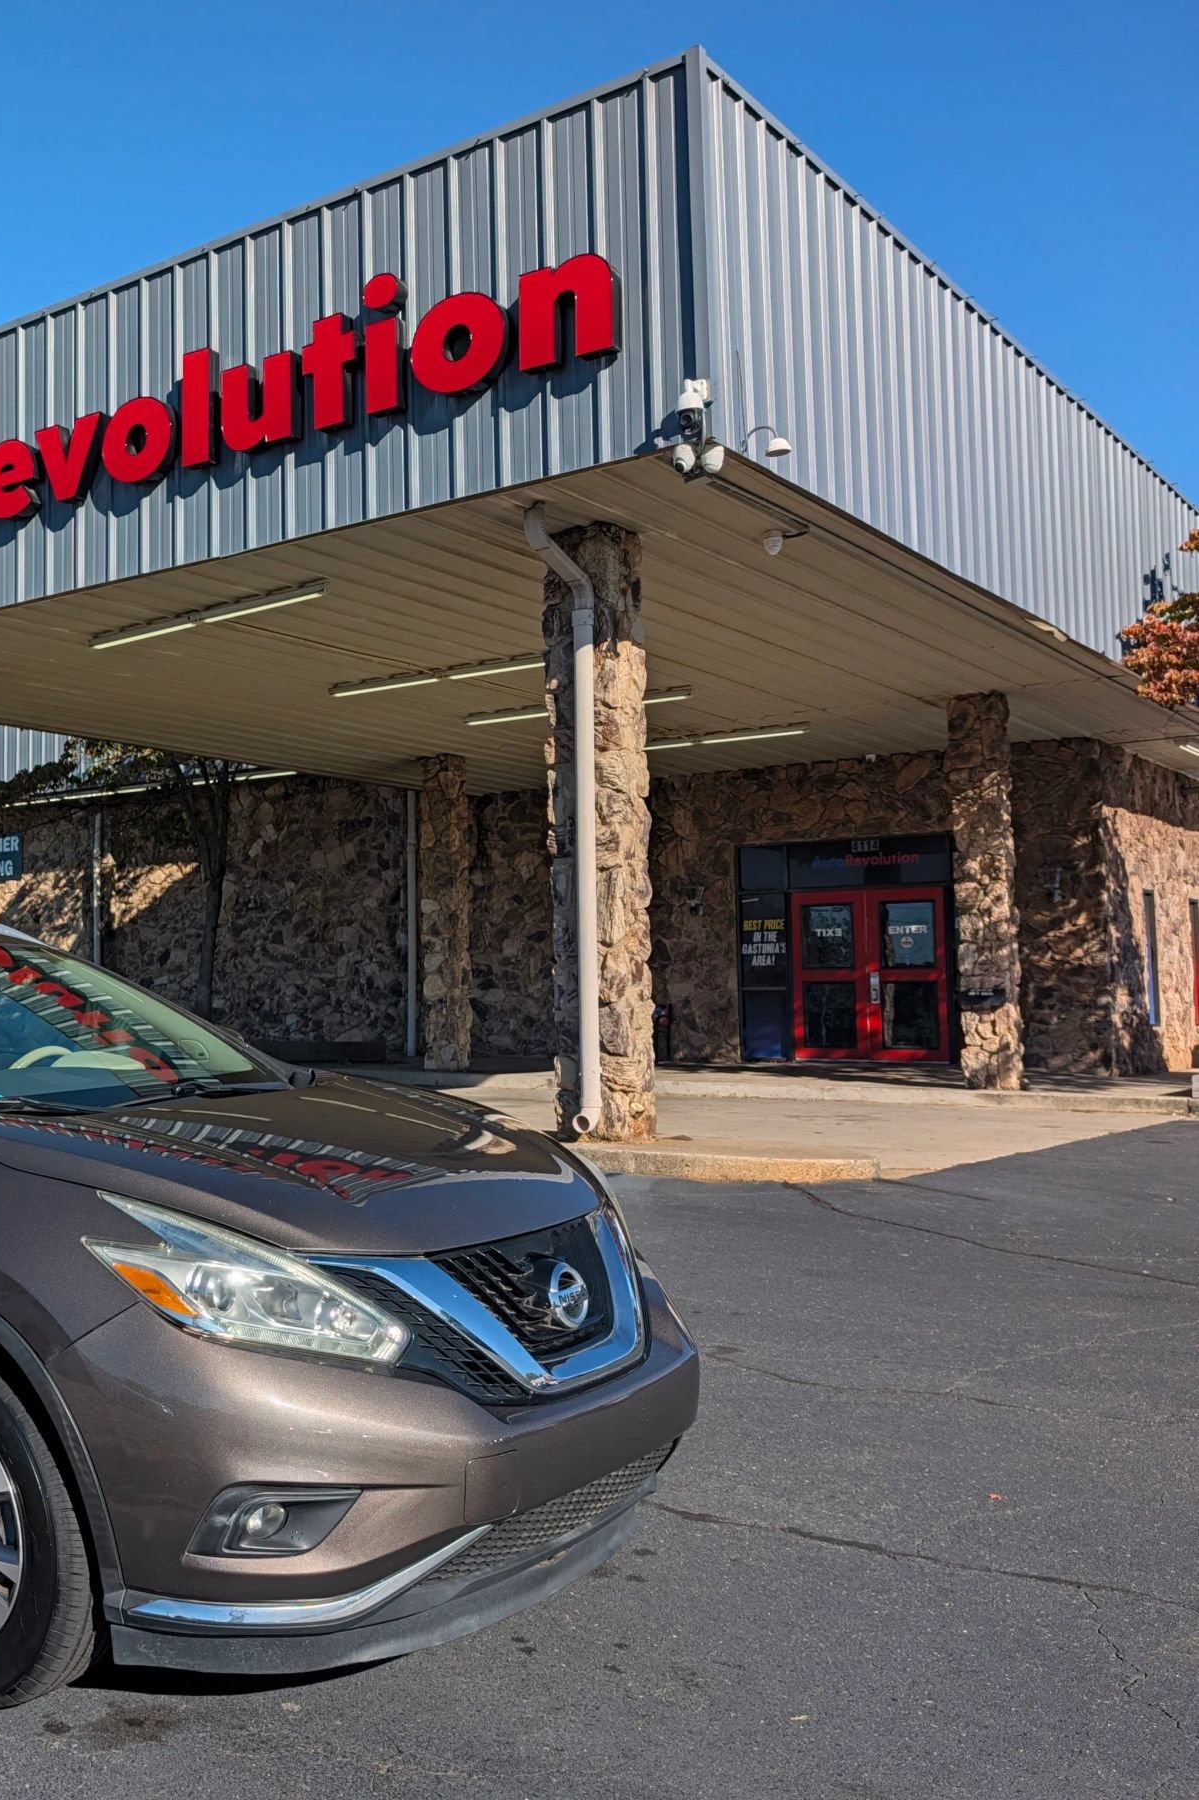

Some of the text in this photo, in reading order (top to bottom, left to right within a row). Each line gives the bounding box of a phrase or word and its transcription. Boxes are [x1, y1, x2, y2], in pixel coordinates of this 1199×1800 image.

[743, 918, 785, 931] BEST PRICE
[888, 925, 928, 935] ENTER
[753, 931, 778, 943] IN THE
[742, 942, 786, 954] GASTONIA'S
[751, 955, 775, 967] AREA!
